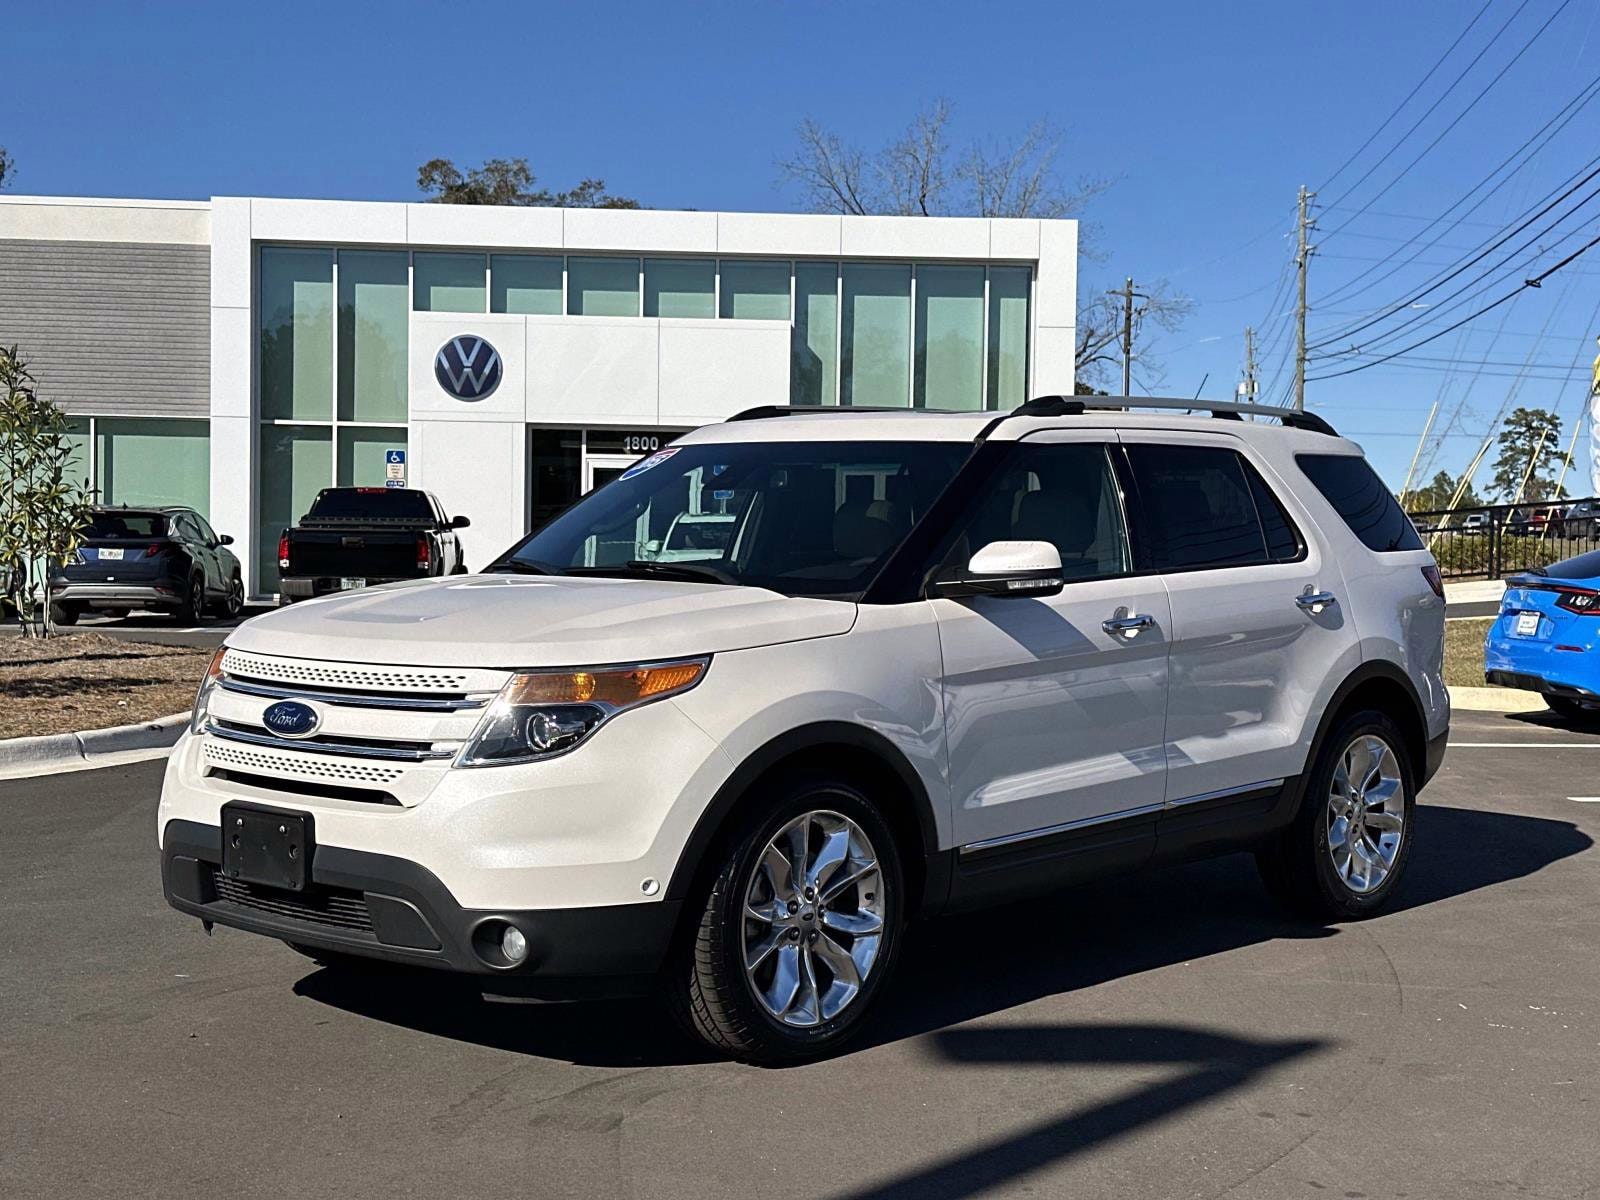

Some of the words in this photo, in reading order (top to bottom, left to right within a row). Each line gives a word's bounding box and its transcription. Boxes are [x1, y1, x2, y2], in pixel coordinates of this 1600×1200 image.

[438, 337, 499, 396] VW
[624, 436, 658, 450] 1800
[270, 705, 302, 726] Ford
